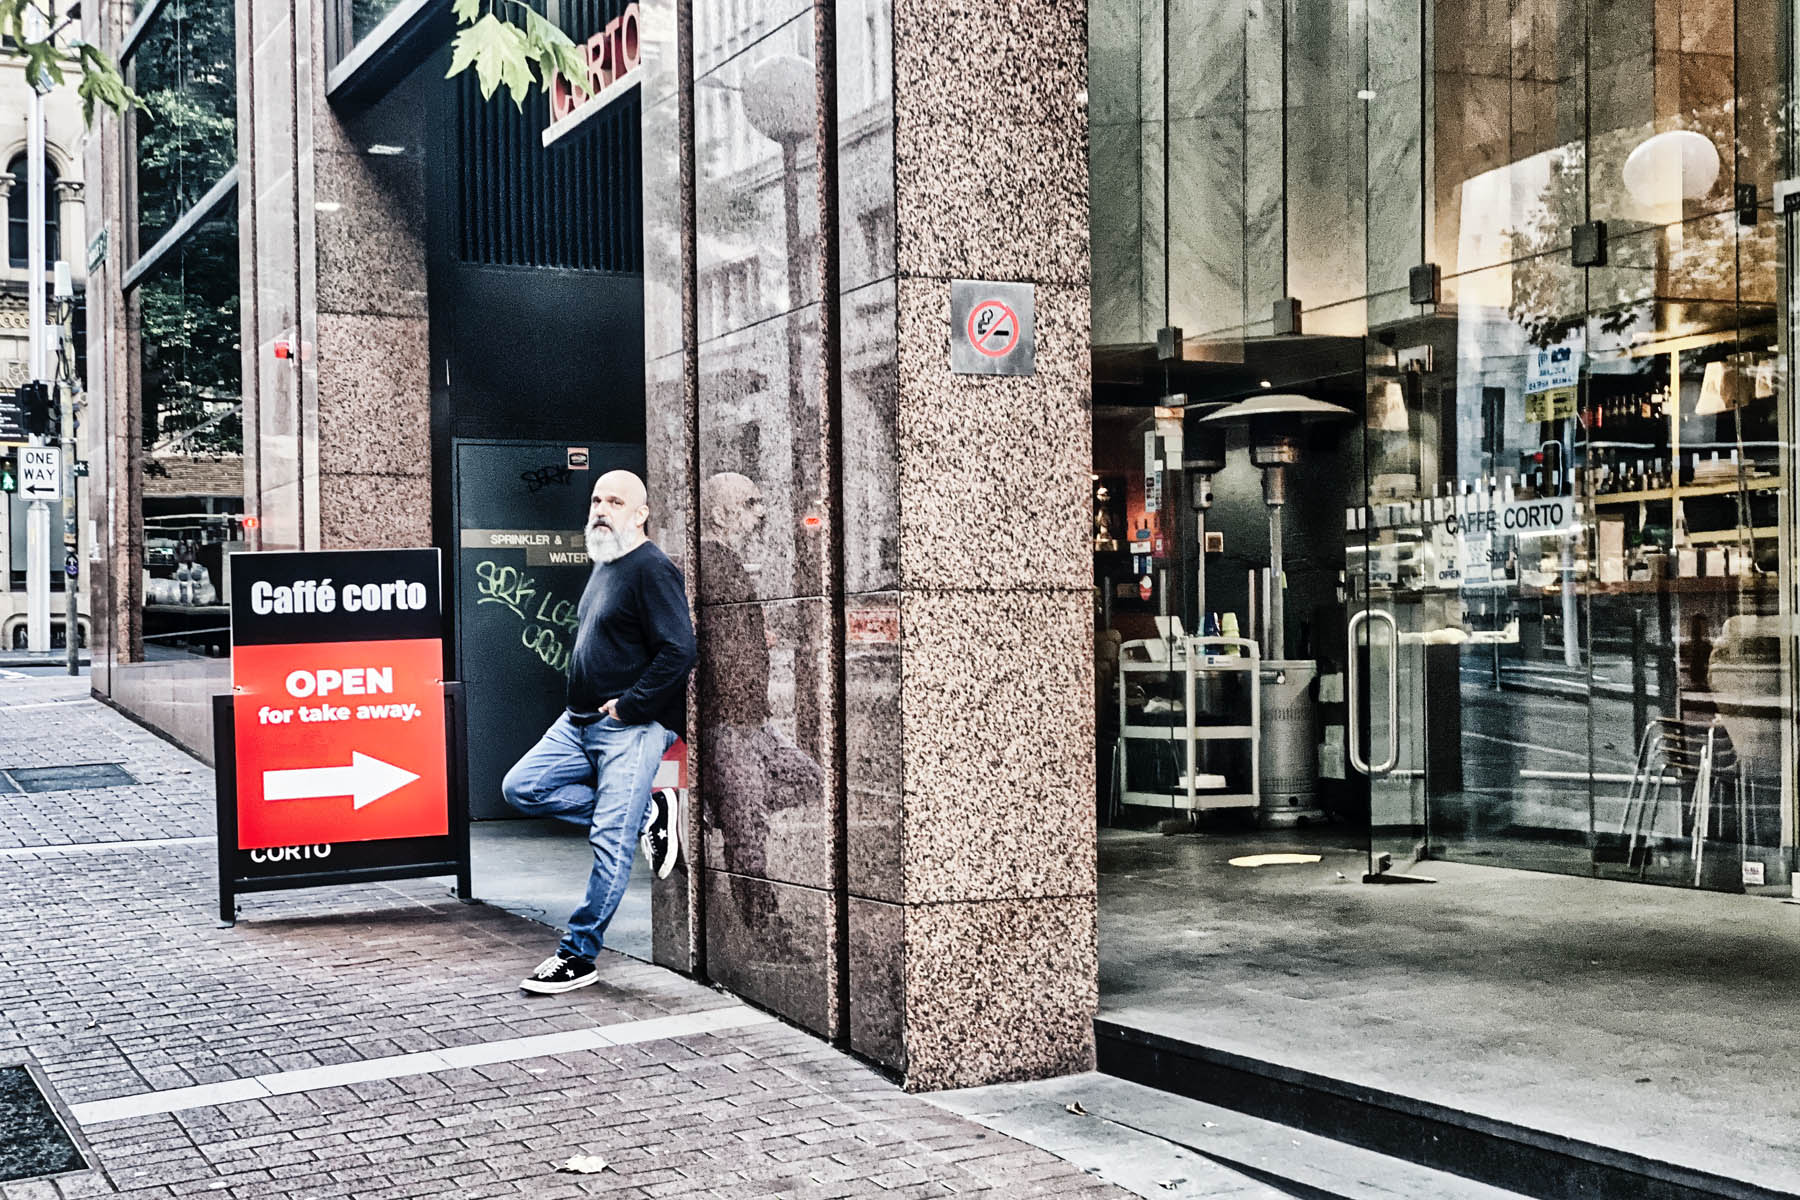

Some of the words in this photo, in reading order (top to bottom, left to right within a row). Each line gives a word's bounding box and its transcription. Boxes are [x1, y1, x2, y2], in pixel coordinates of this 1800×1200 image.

[25, 452, 53, 464] ONE
[24, 468, 55, 480] WAY
[1504, 503, 1563, 530] CORTO
[490, 534, 550, 545] SPRINKLER
[554, 535, 562, 545] &
[549, 552, 588, 564] WATER
[1439, 570, 1461, 580] OPEN
[251, 579, 336, 615] Caffé
[342, 580, 427, 612] corto
[285, 667, 393, 698] OPEN
[258, 706, 293, 724] for
[298, 704, 350, 722] take
[356, 703, 422, 721] away.
[250, 843, 332, 863] CORTO
